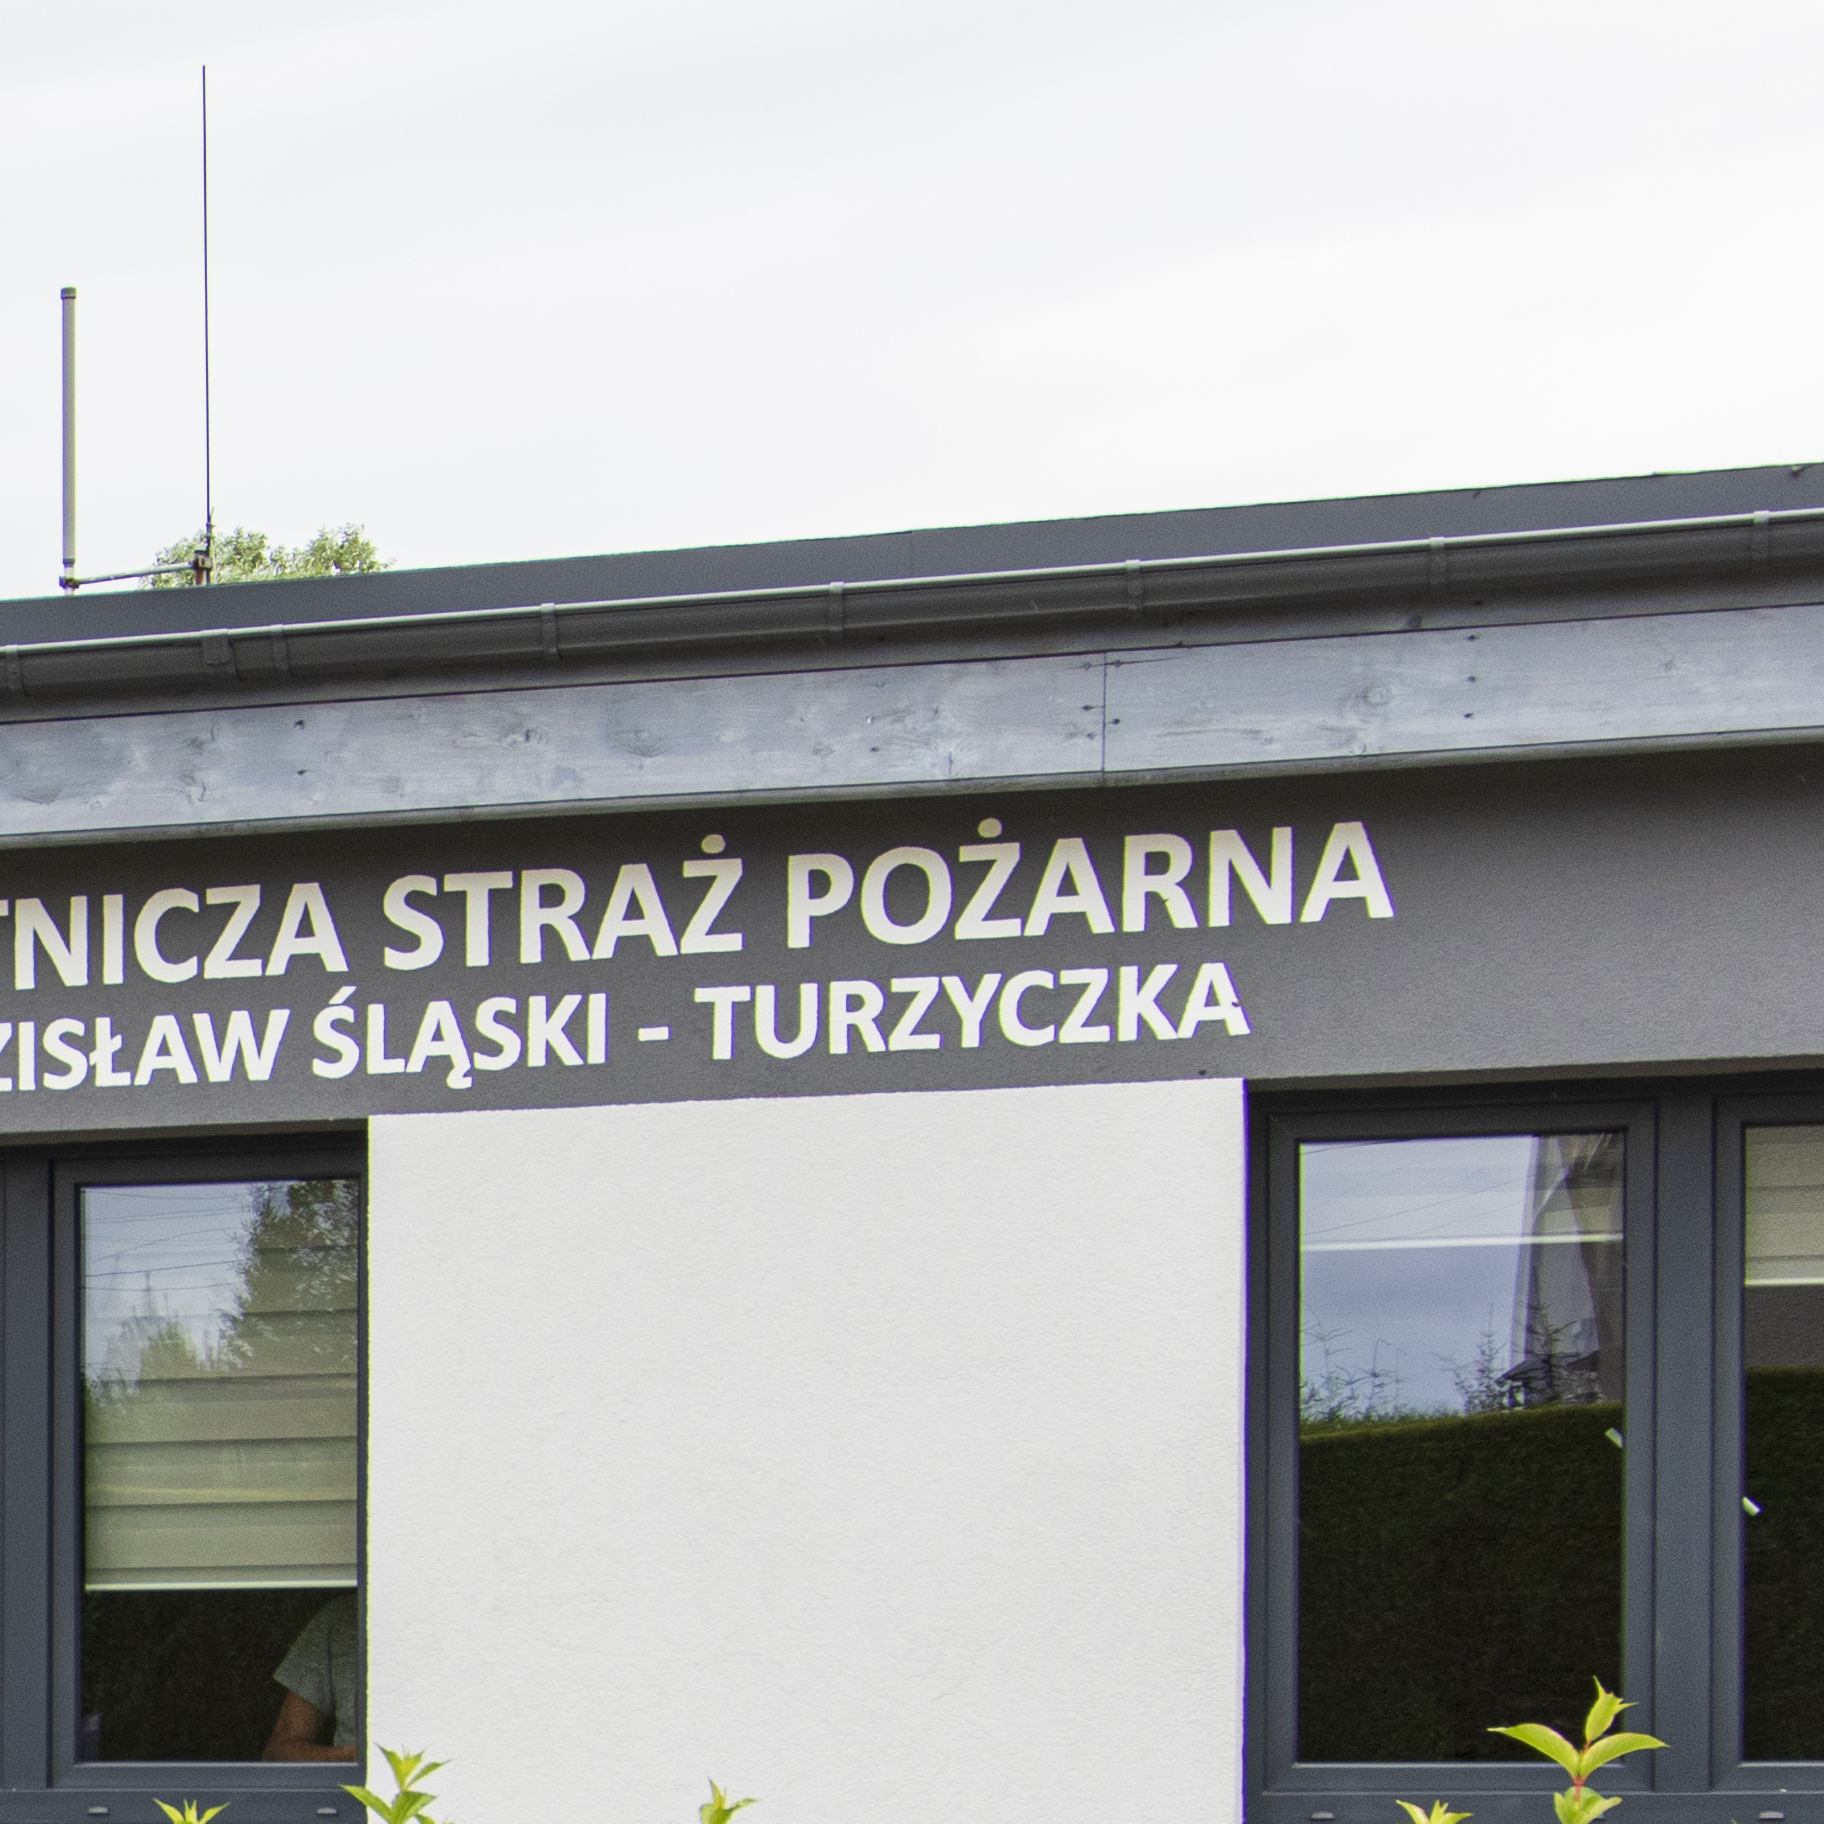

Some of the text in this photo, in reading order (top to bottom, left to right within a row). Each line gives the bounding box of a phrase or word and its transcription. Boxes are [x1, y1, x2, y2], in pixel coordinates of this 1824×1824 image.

[383, 834, 745, 972] STRAŻ
[786, 817, 1395, 951] POŻARNA
[309, 985, 608, 1091] ŚLĄSKI
[692, 961, 1251, 1062] TURZYCZKA
